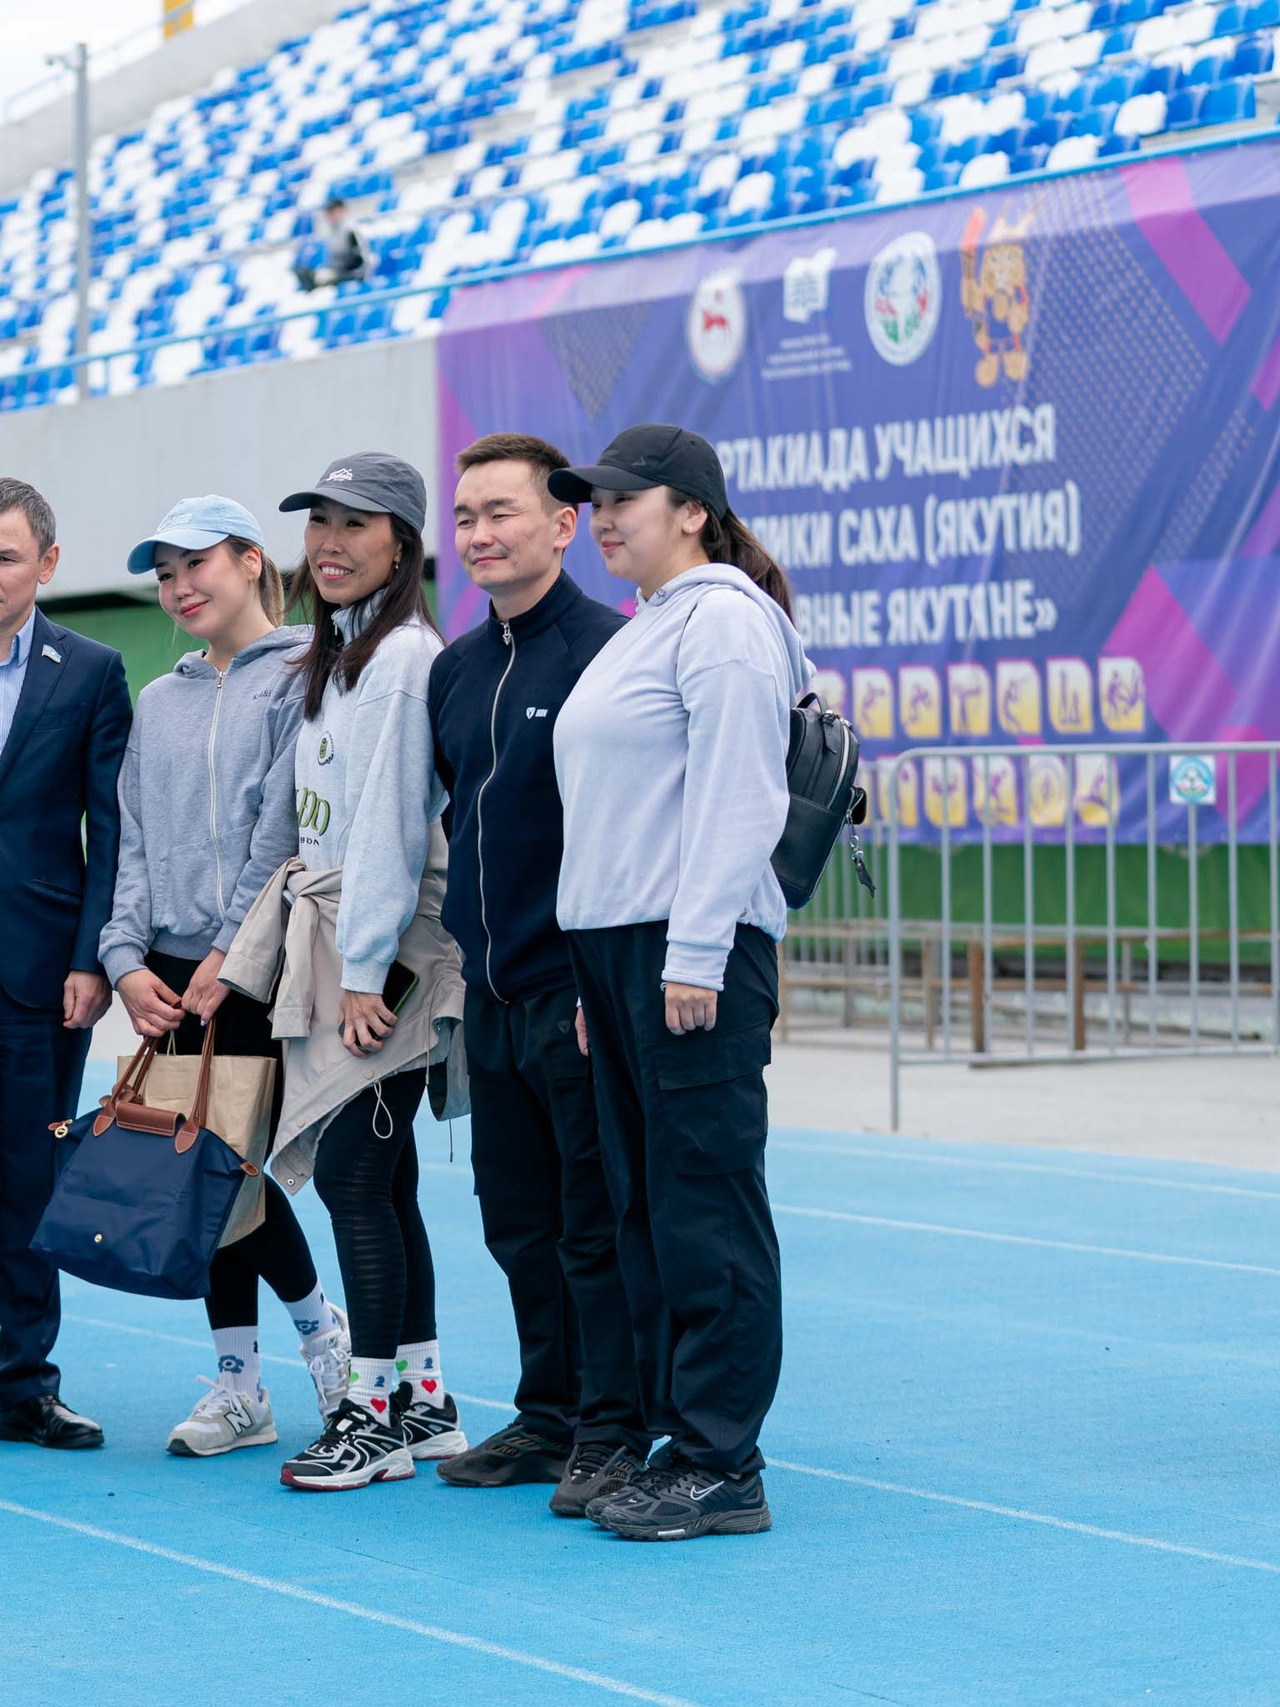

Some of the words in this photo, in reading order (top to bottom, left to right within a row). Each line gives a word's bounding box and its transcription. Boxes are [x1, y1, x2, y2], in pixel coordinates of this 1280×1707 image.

[717, 427, 870, 492] РТАКИАДА
[874, 403, 1056, 481] УЧАЩИХСЯ
[738, 511, 832, 569] ЛИКИ
[838, 504, 918, 567] САХА
[924, 479, 1081, 568] (ЯКУТИЯ)
